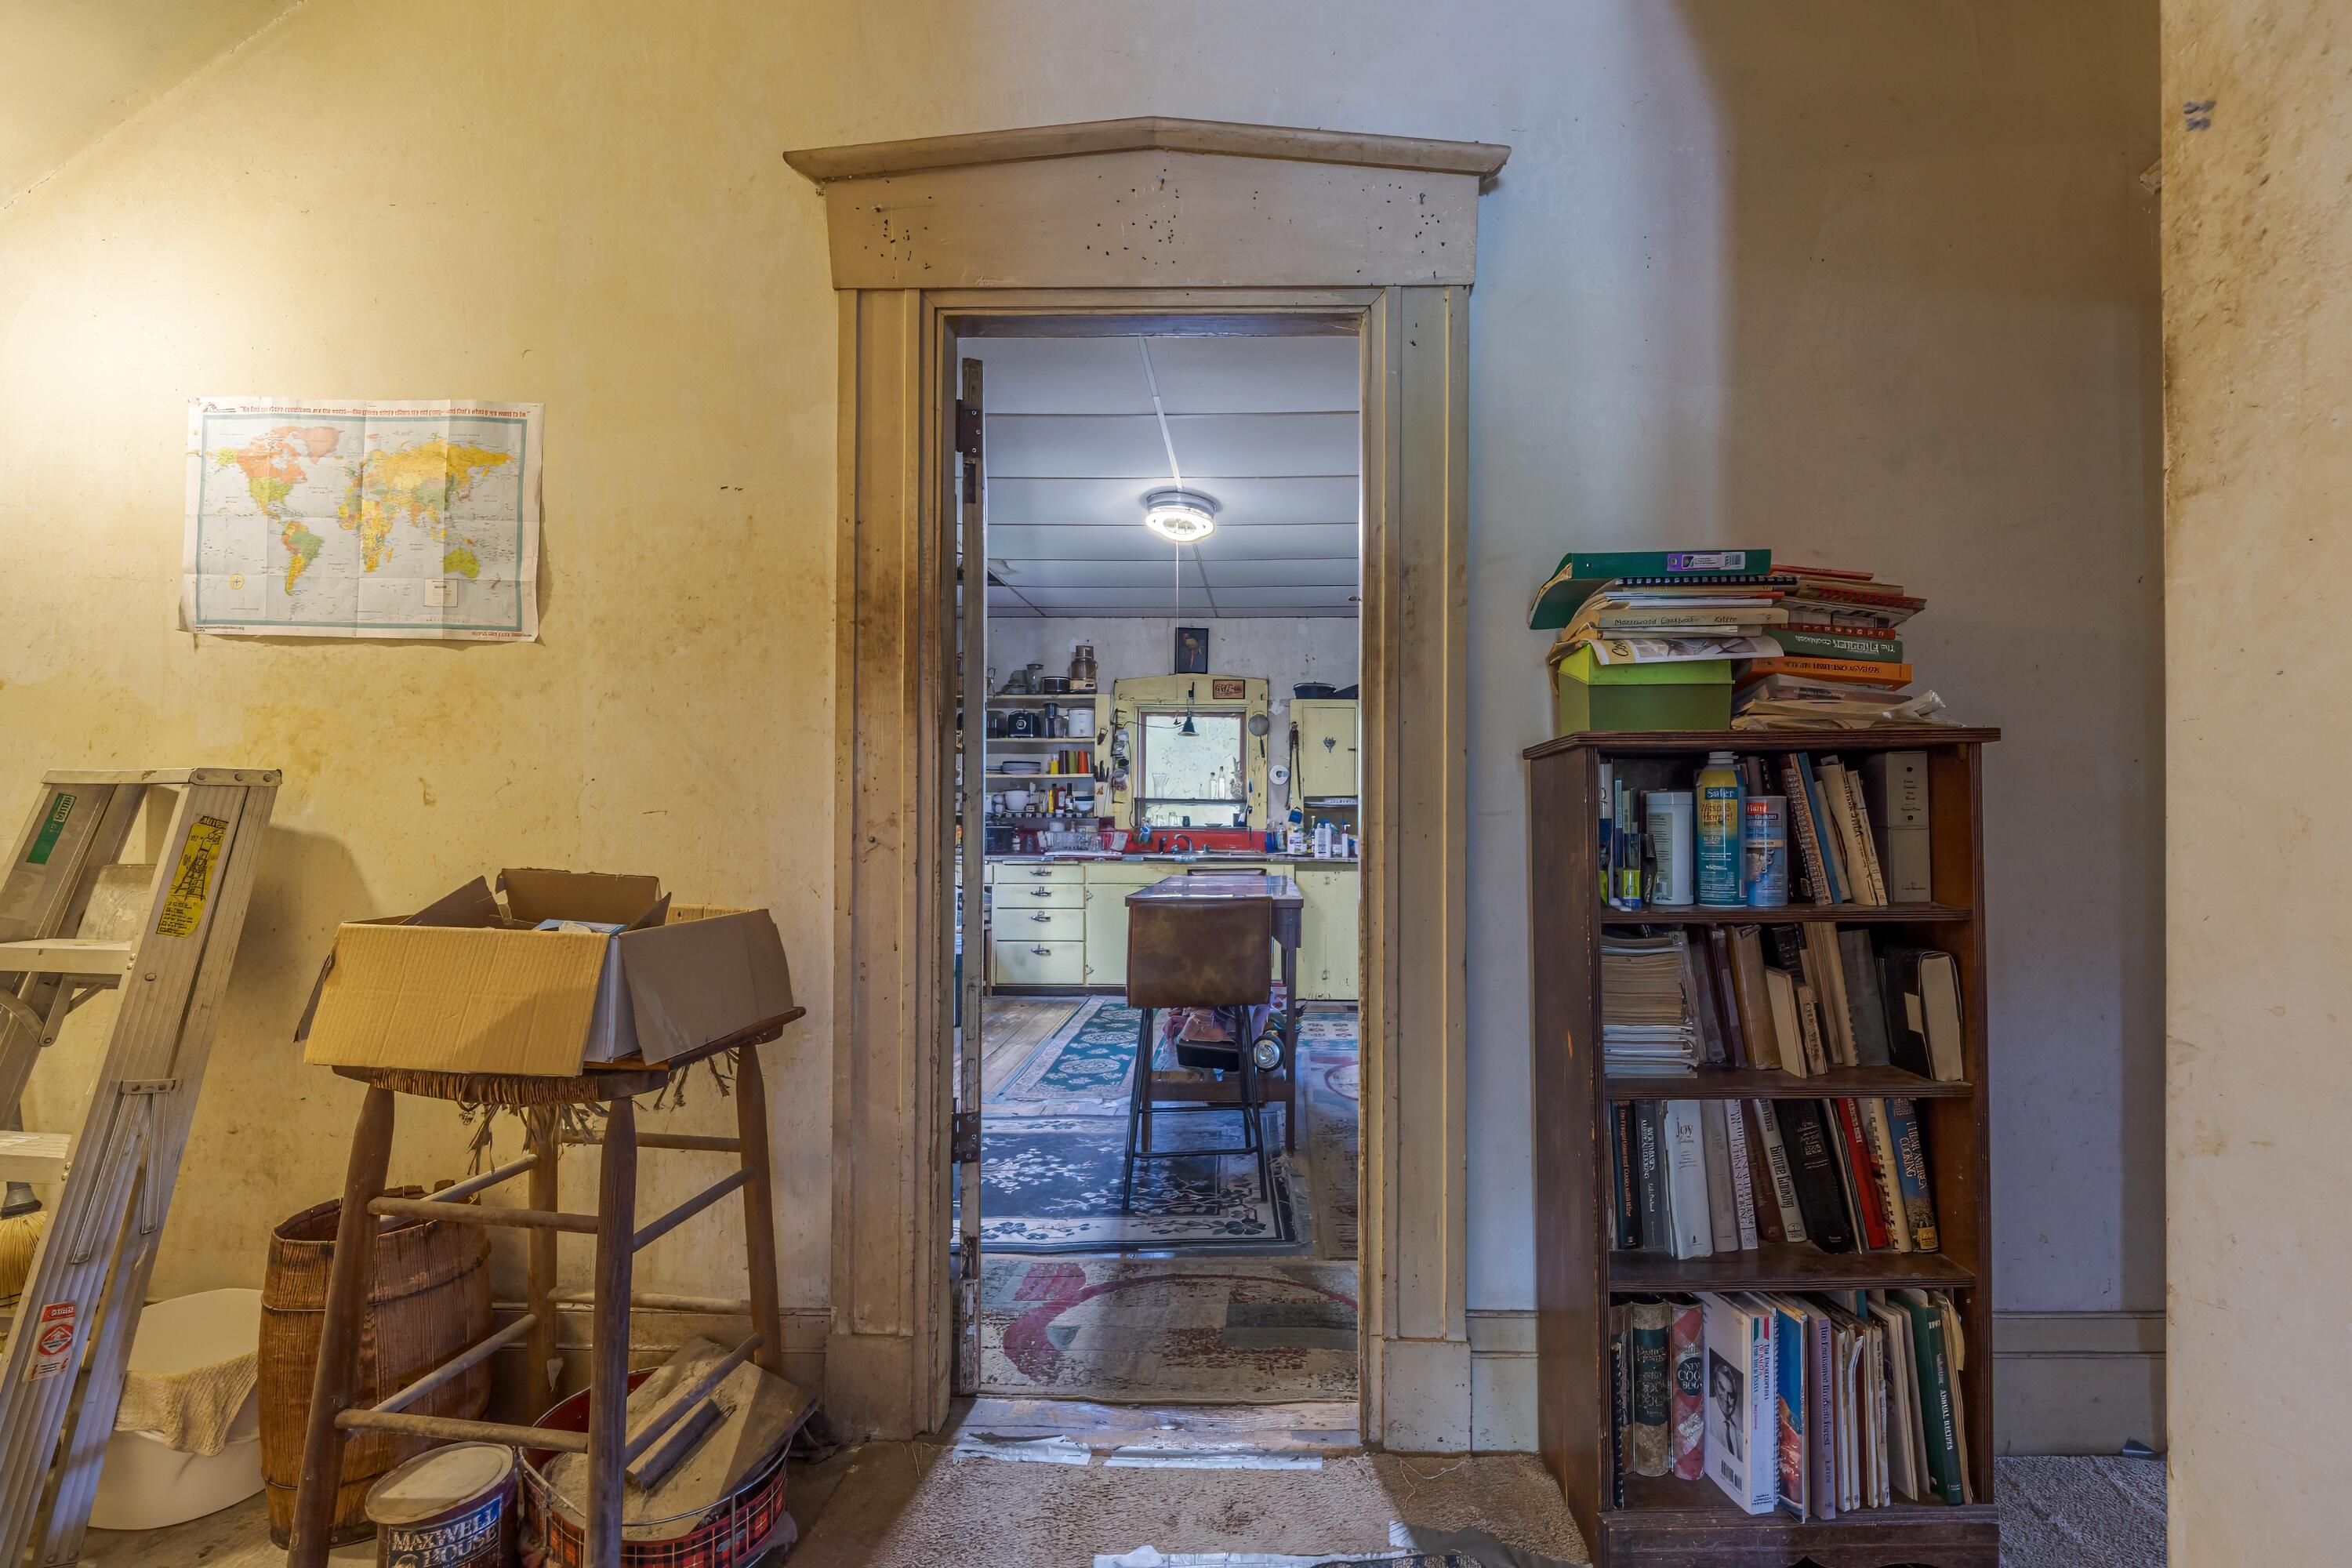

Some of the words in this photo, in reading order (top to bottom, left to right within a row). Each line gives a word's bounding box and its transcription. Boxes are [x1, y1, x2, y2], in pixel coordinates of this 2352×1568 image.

[1676, 1117, 1693, 1138] joy
[1899, 1137, 1917, 1178] COOKING
[1677, 1369, 1700, 1381] COO
[392, 1507, 497, 1552] MAXWELL
